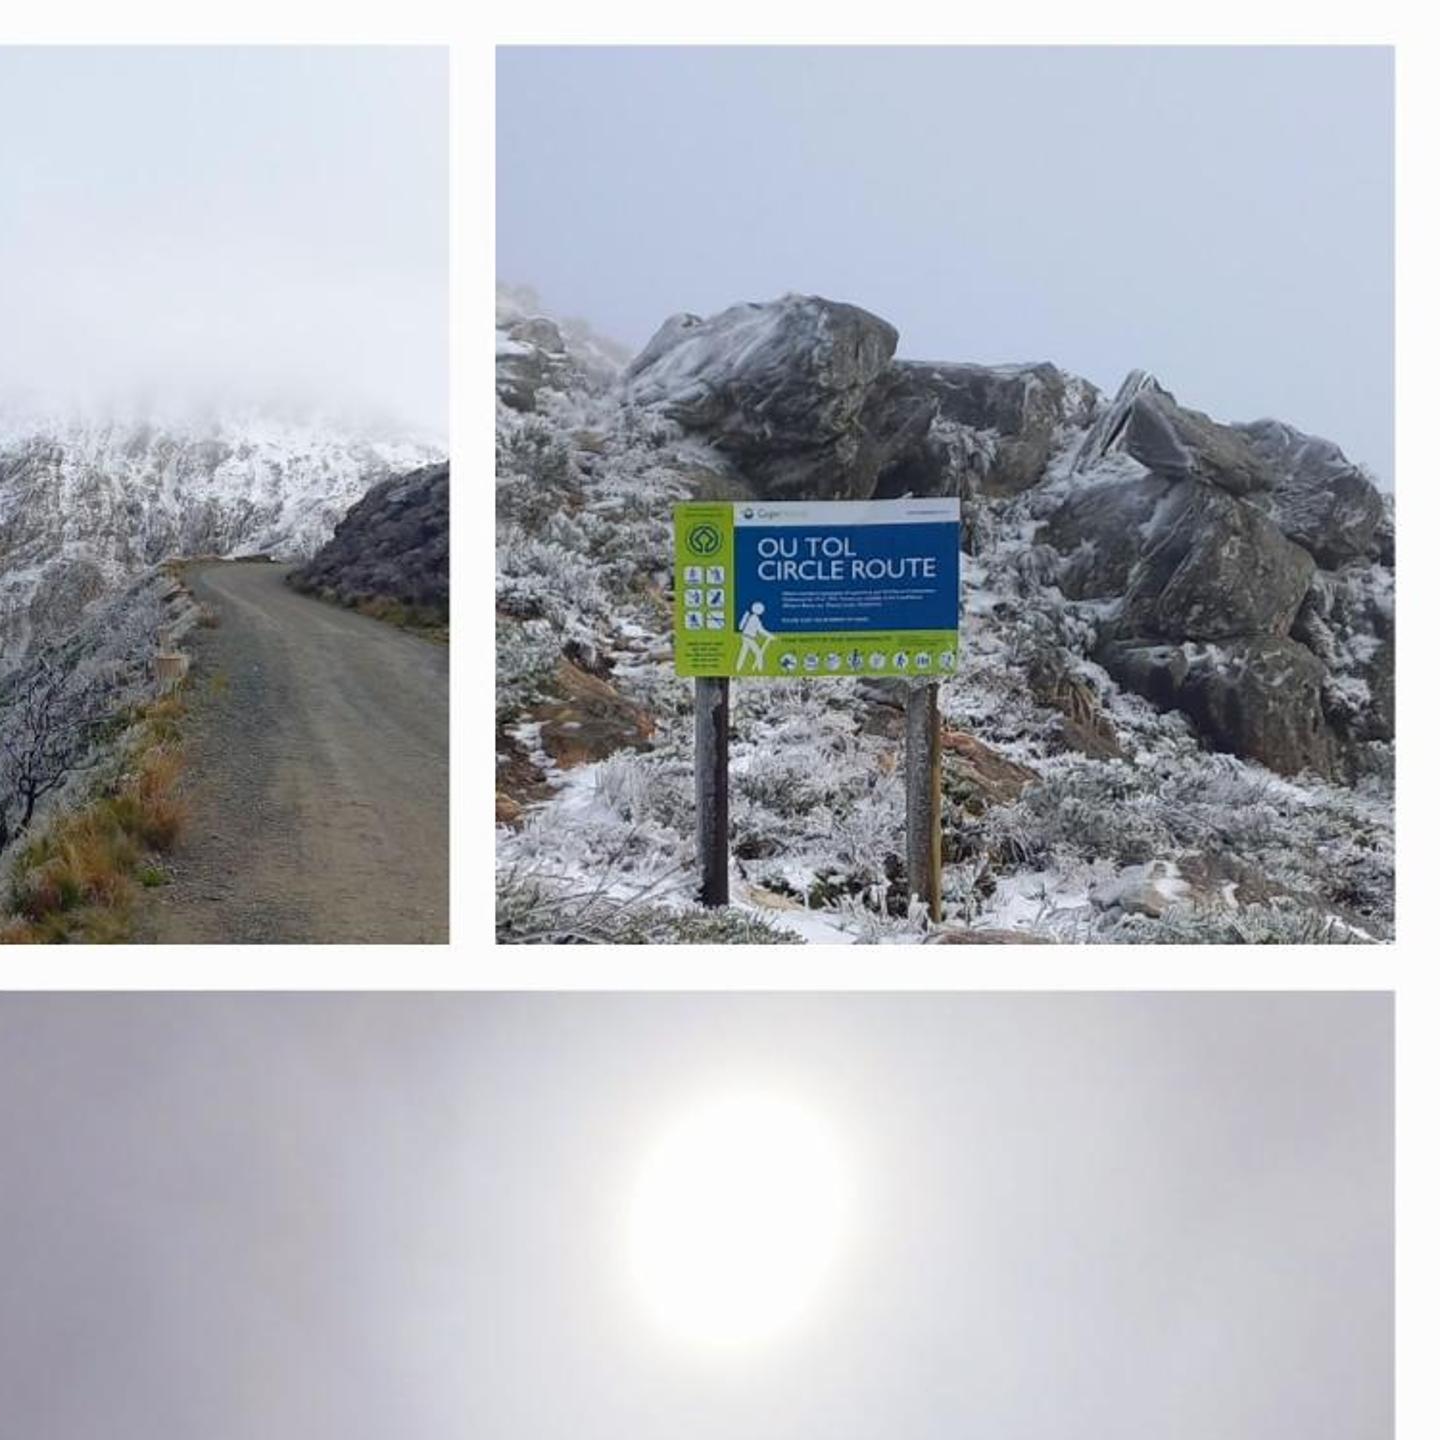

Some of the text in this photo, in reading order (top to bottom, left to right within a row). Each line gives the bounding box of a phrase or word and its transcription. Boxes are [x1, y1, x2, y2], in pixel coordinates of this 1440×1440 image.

[757, 537, 857, 558] OU TOL
[757, 558, 937, 581] CIRCLE ROUTE
